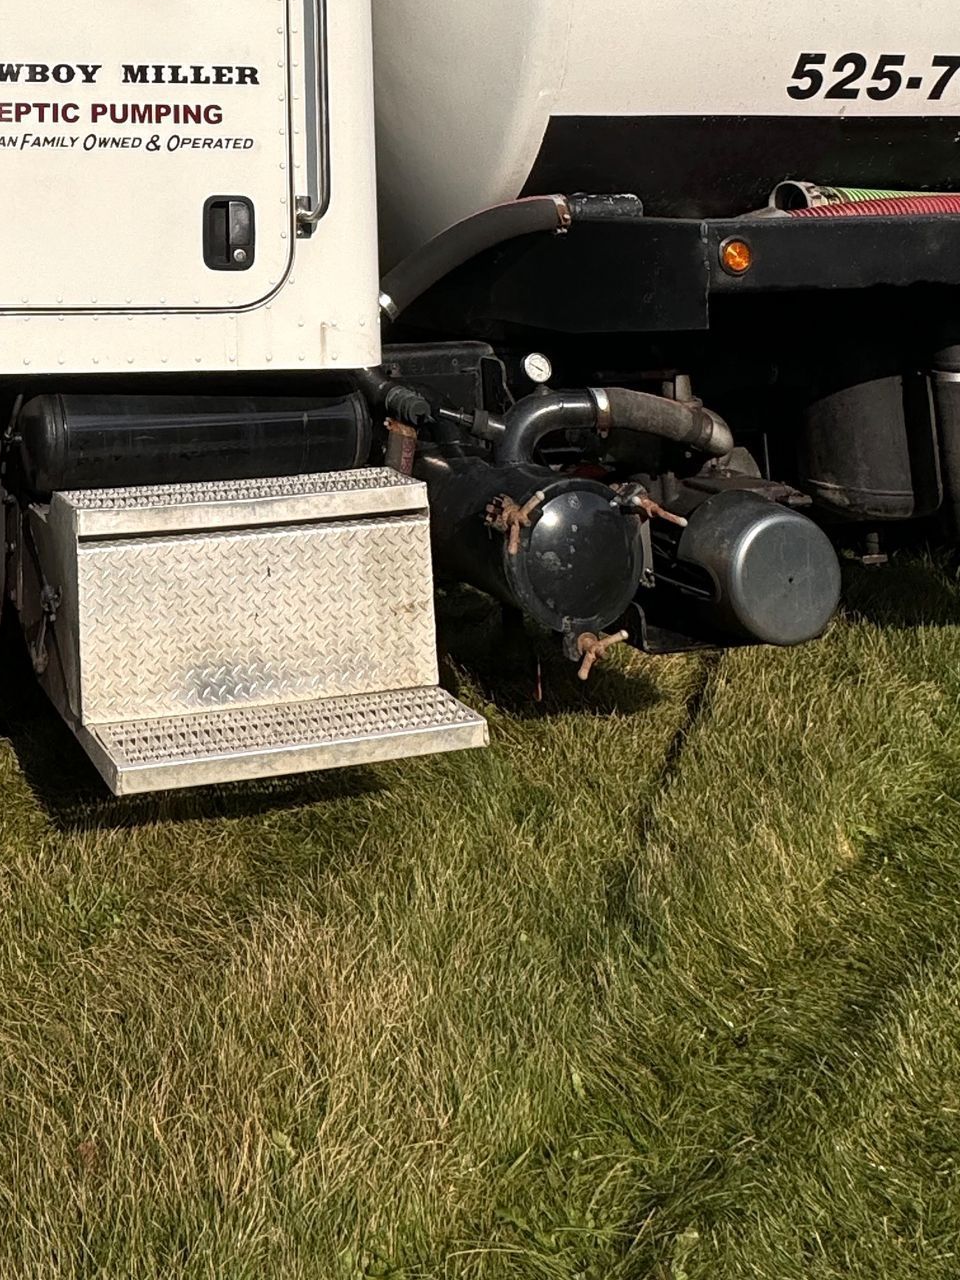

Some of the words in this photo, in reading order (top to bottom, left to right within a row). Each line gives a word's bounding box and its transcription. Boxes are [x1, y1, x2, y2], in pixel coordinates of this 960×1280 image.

[122, 64, 260, 85] MILLER
[786, 52, 960, 100] 525-7
[91, 103, 223, 124] PUMPING
[146, 134, 161, 151] &
